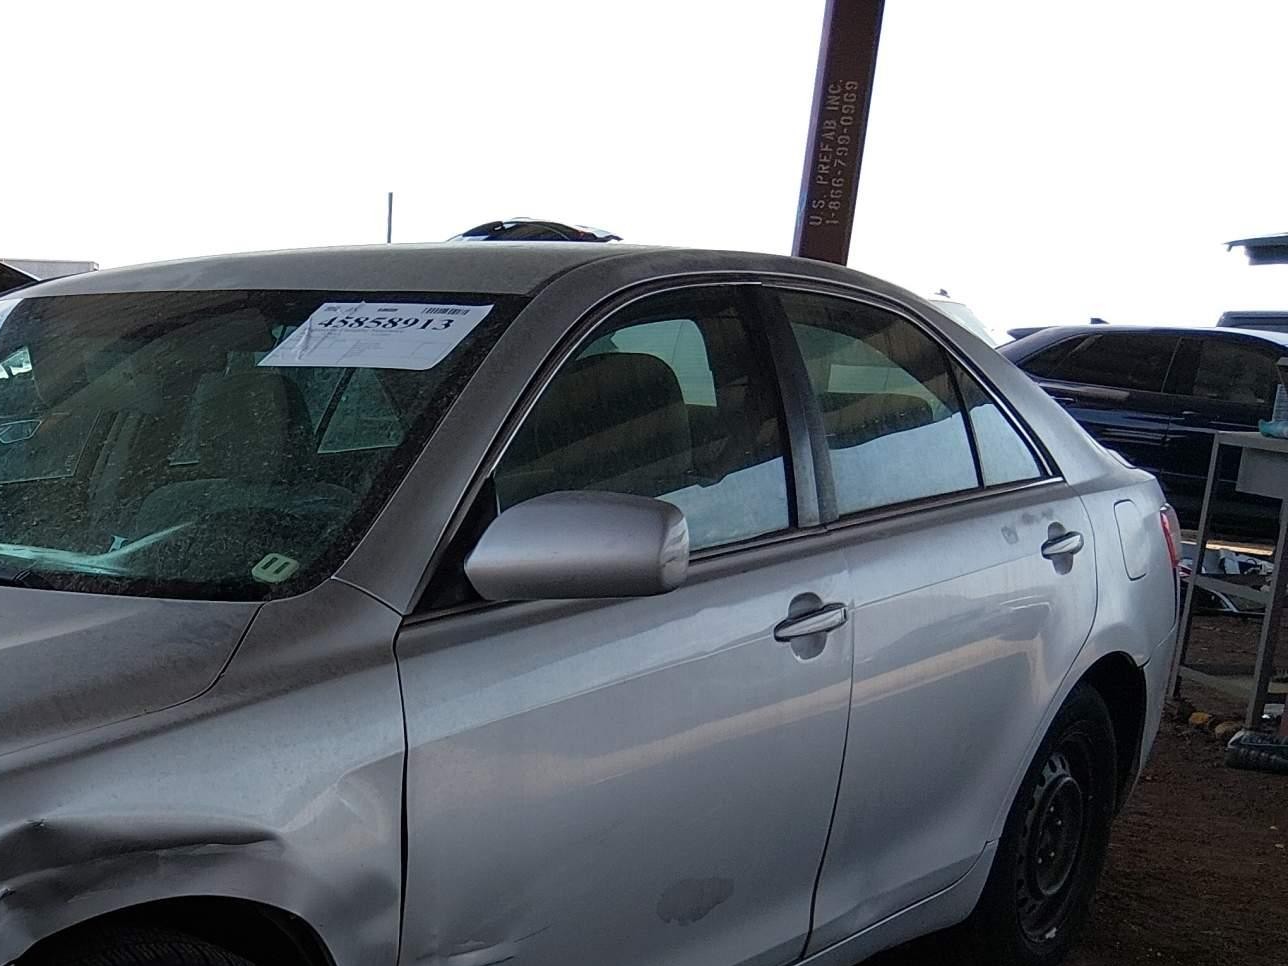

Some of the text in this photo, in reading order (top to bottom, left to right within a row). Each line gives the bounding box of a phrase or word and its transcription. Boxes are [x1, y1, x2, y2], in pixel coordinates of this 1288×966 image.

[826, 79, 844, 111] INC.
[816, 119, 838, 185] PREFAB
[317, 315, 455, 331] 45858913
